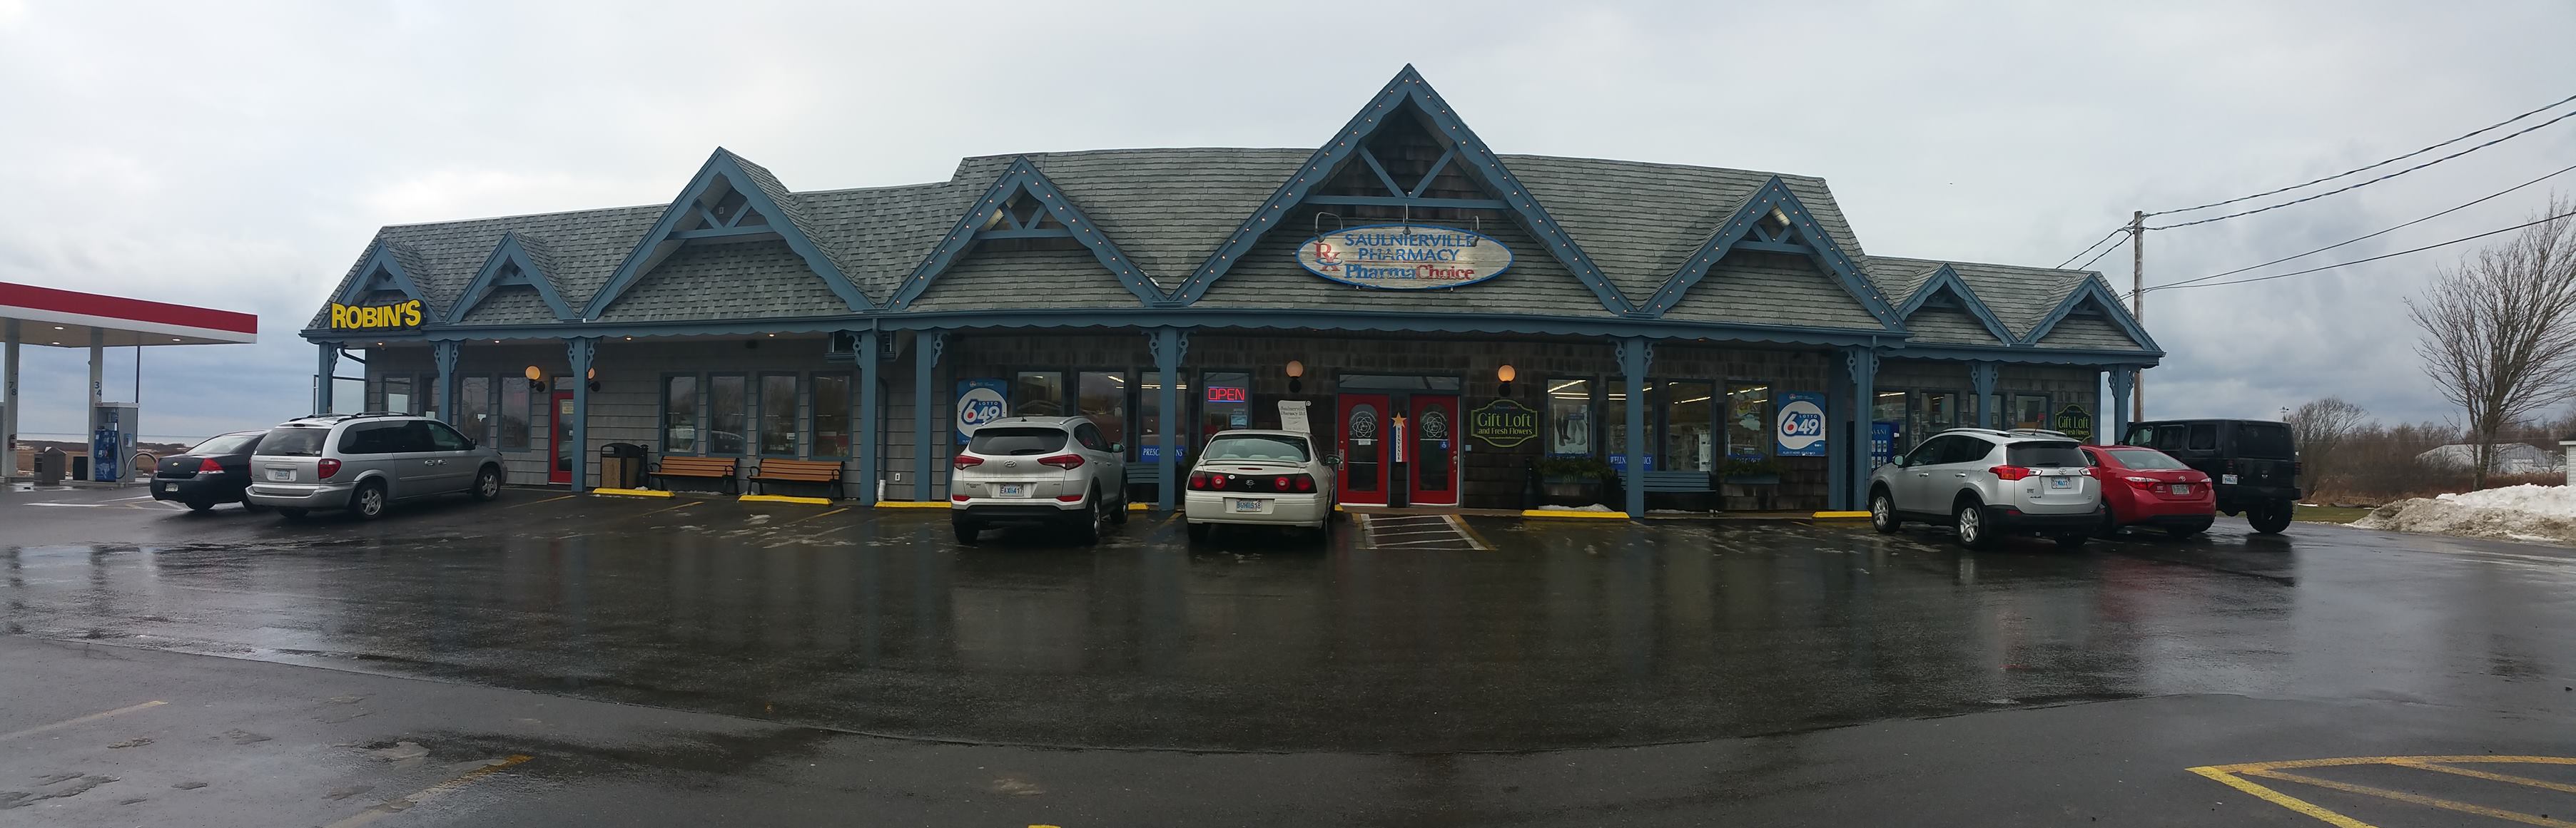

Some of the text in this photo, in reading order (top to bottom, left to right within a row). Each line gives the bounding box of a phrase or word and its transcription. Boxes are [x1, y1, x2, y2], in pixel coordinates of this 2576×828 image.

[1344, 233, 1477, 247] SAULNIERVILLE
[1358, 248, 1460, 261] PHARMACY
[1344, 264, 1475, 280] PharmaChoice
[332, 300, 421, 329] ROBIN'S
[1208, 388, 1245, 400] OPEN
[1478, 413, 1532, 427] Gift Loft
[2058, 416, 2089, 429] Gift Loft
